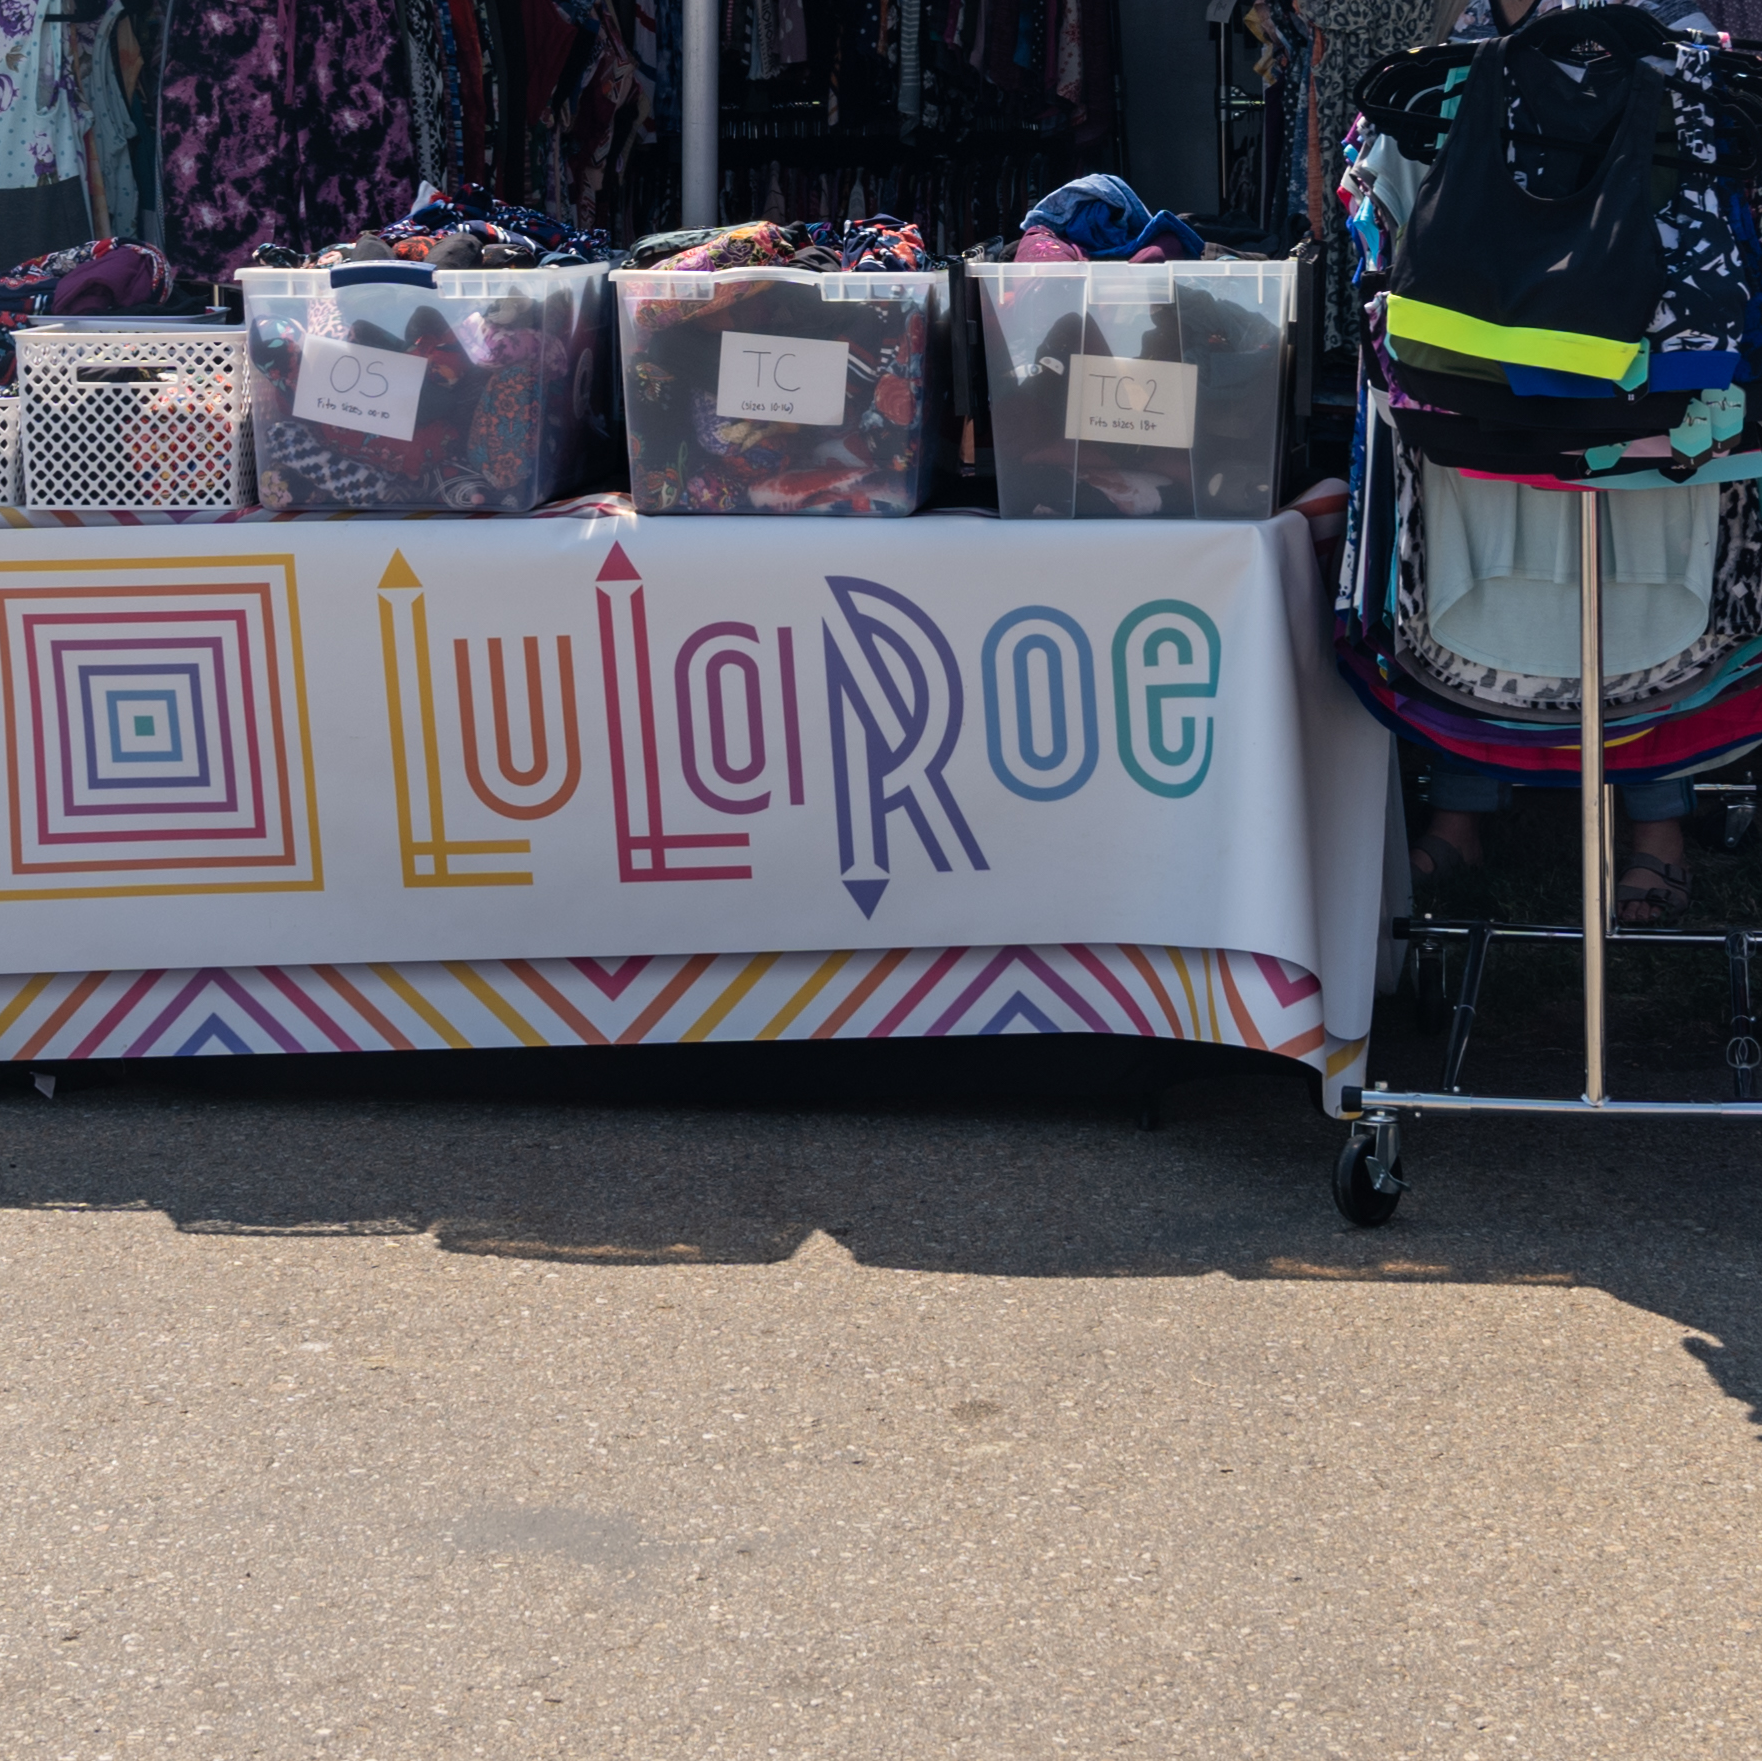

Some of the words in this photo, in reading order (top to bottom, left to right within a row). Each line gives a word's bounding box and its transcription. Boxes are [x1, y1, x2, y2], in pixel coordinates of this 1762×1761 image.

[329, 354, 389, 398] OS
[742, 350, 801, 392] TC
[317, 397, 337, 410] Fits
[1089, 416, 1108, 428] Fits
[1112, 417, 1135, 430] sizes
[1140, 419, 1157, 431] 18+
